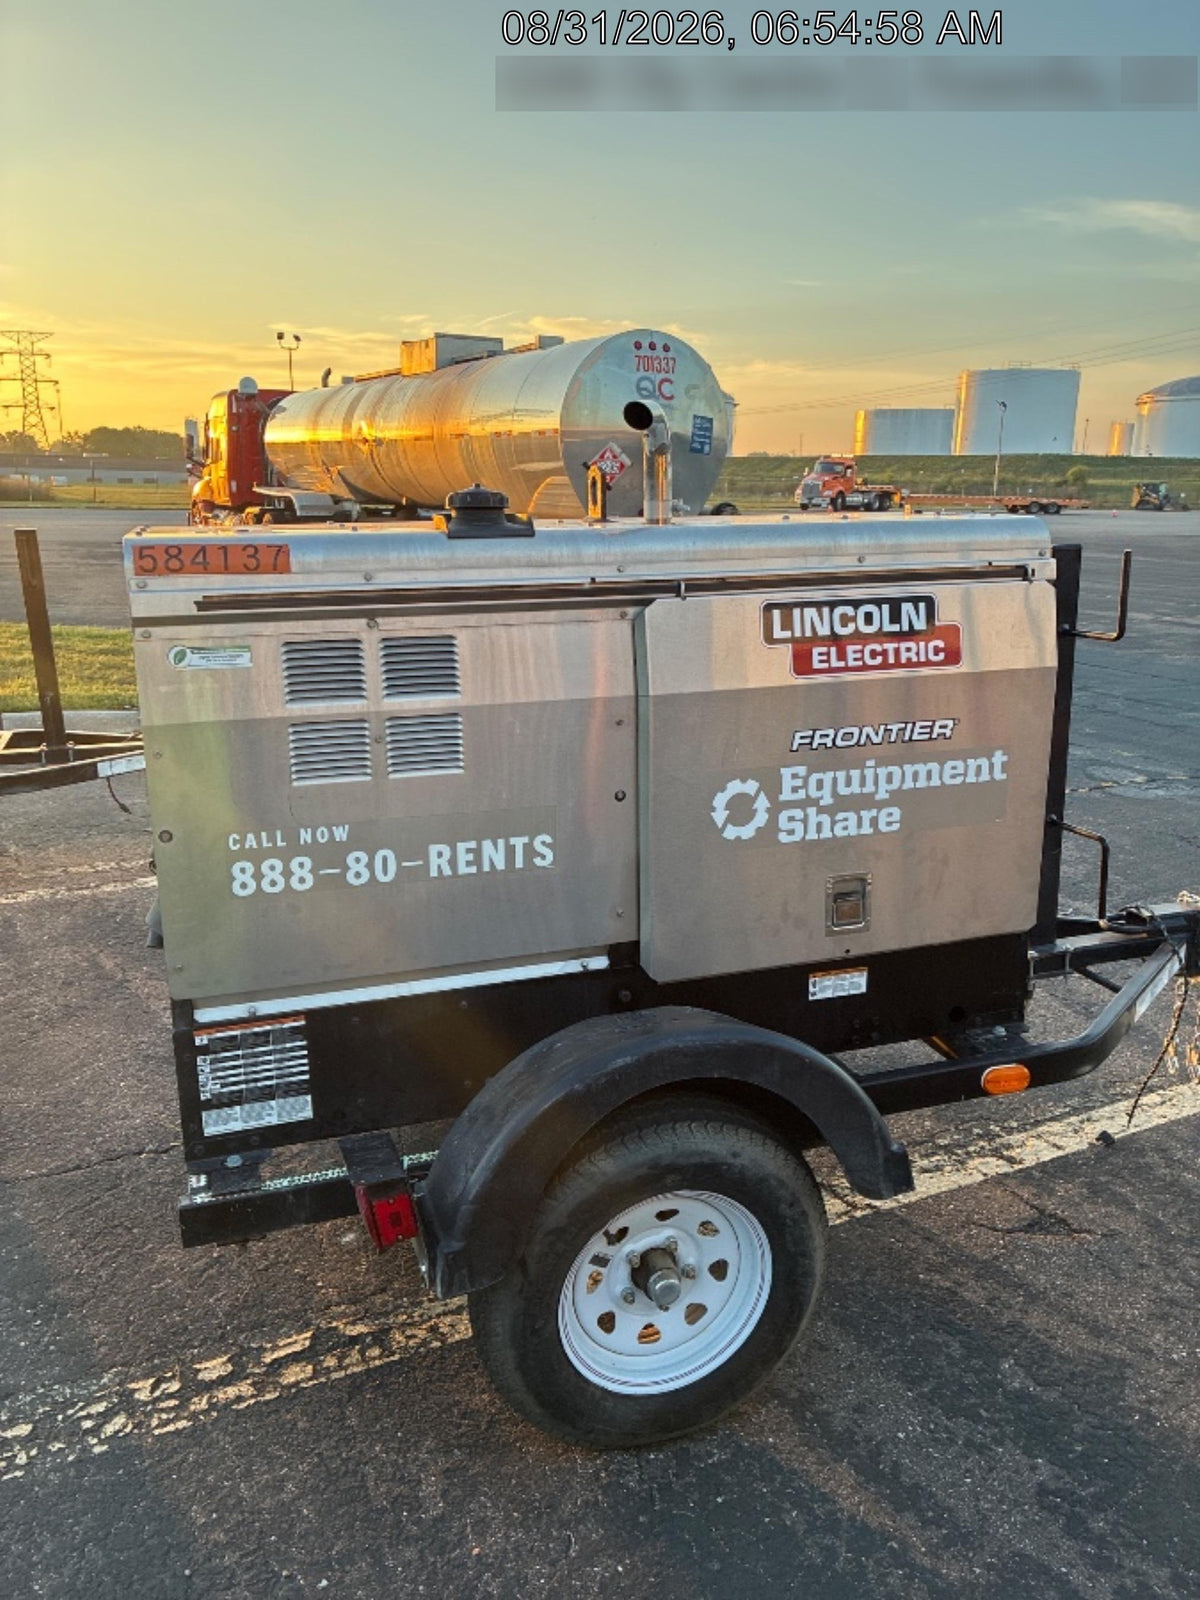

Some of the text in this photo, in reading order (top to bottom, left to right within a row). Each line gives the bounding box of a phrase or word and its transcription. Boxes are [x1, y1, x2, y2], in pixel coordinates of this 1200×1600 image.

[634, 355, 677, 374] 701337
[635, 376, 675, 400] QC
[138, 544, 284, 573] 584137
[771, 601, 928, 639] LINCOLN
[811, 639, 946, 669] ELECTRIC
[789, 719, 956, 752] FRONTIER
[778, 749, 1009, 806] Equipment
[228, 824, 350, 851] CALL NOW
[777, 806, 902, 844] Share
[231, 833, 554, 897] 888-80-RENTS
